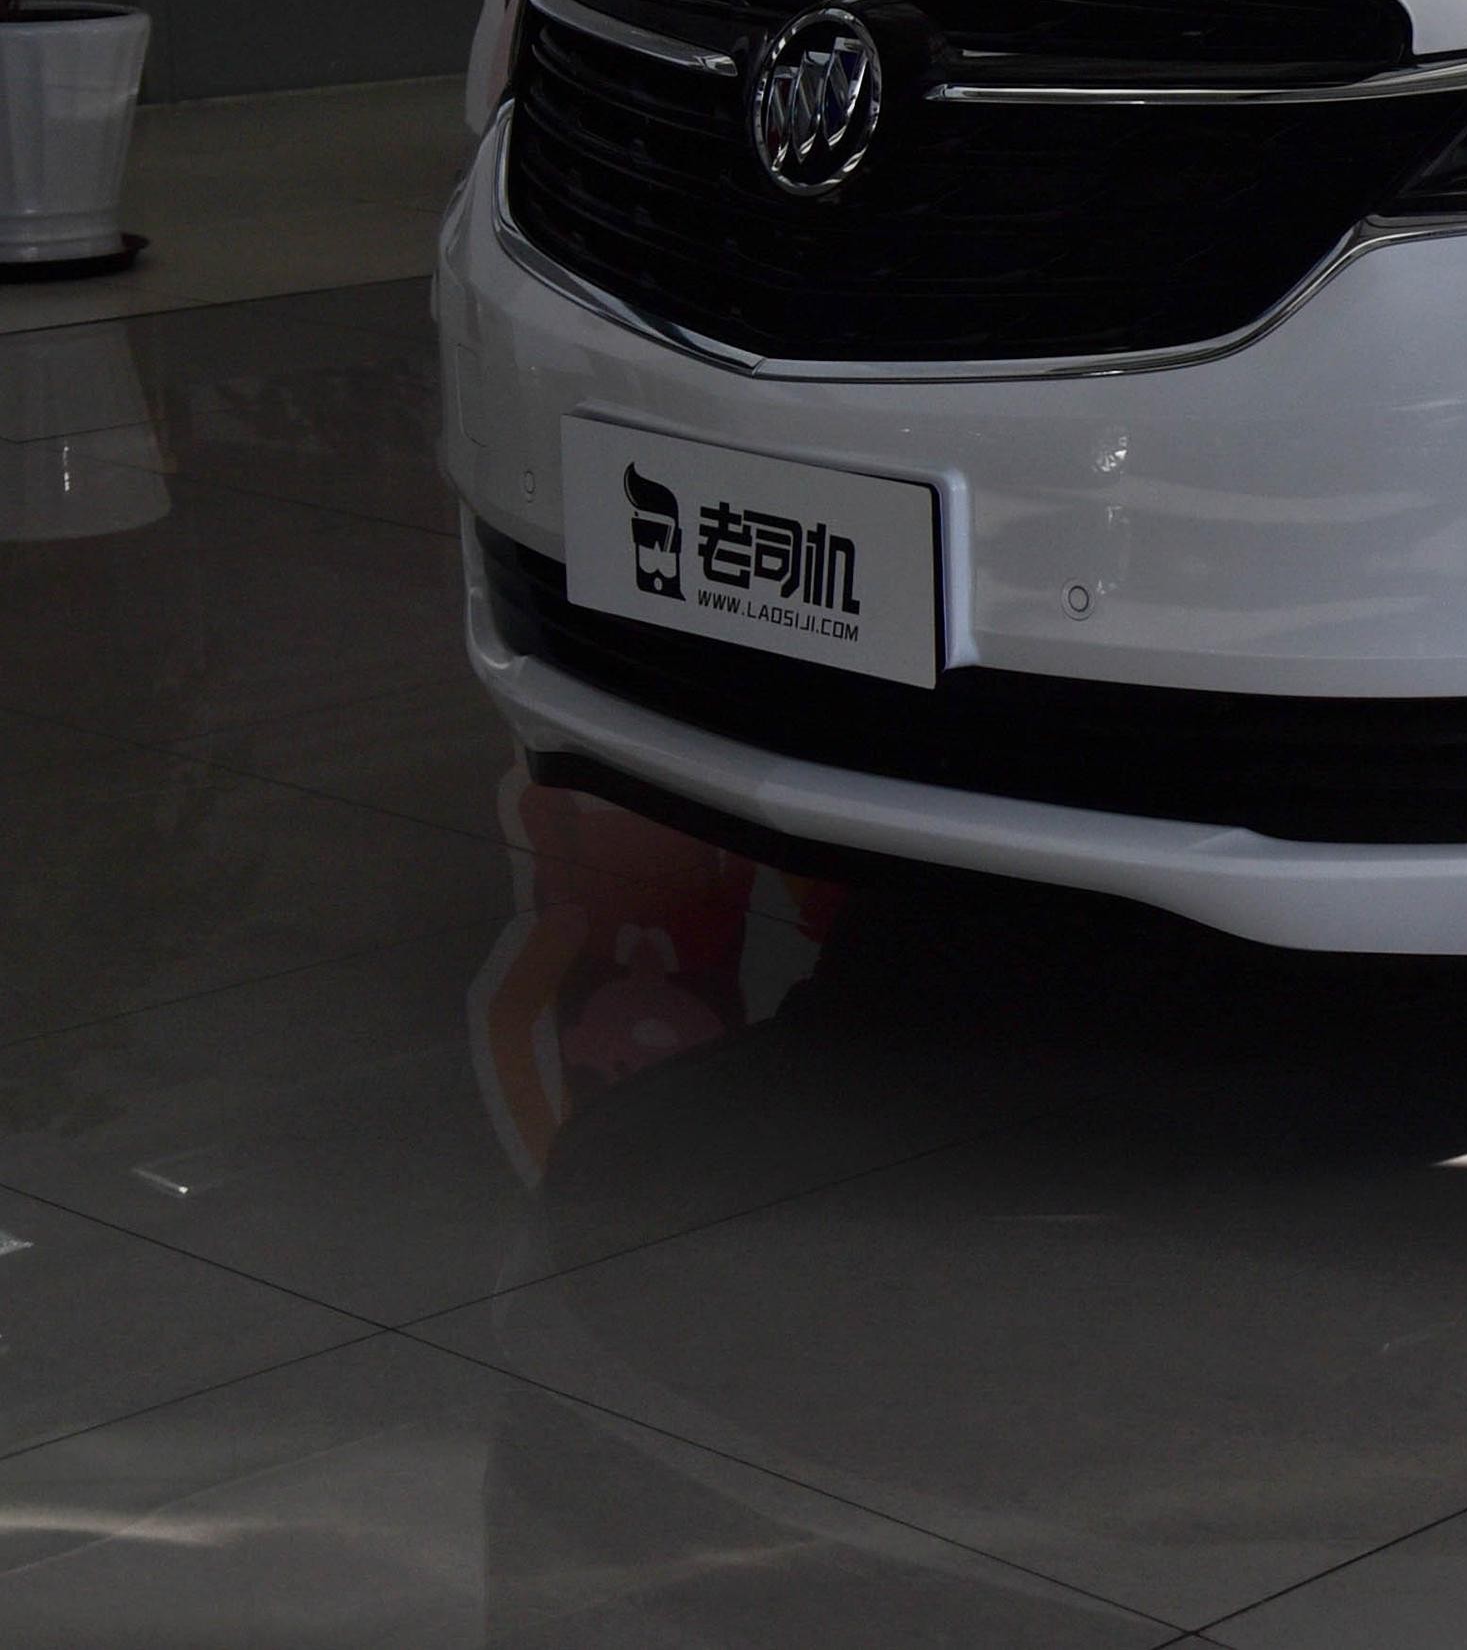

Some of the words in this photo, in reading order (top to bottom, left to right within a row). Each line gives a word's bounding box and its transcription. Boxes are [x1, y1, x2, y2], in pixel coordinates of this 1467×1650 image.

[698, 501, 860, 615] 老司机
[697, 589, 859, 643] WWW.LAOSIJI.COM
